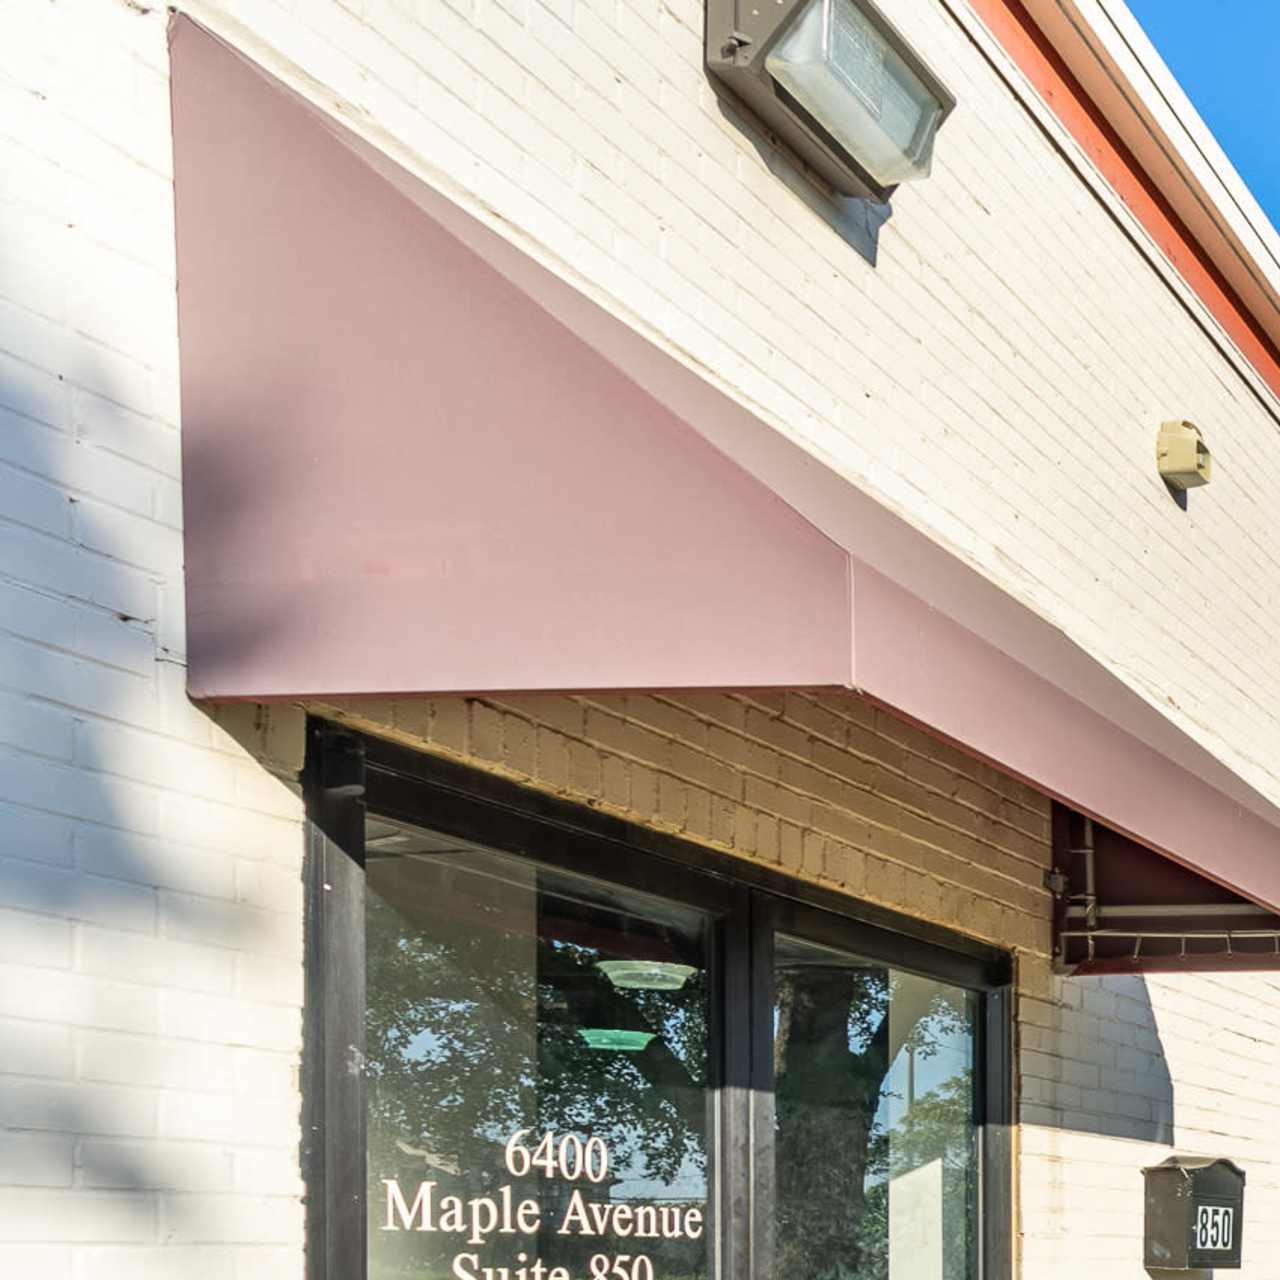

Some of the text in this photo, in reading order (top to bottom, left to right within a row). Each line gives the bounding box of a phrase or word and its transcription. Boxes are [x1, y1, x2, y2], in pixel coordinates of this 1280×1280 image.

[505, 1127, 608, 1183] 6400
[381, 1179, 703, 1245] Maple Avenue
[1200, 1208, 1230, 1247] 850
